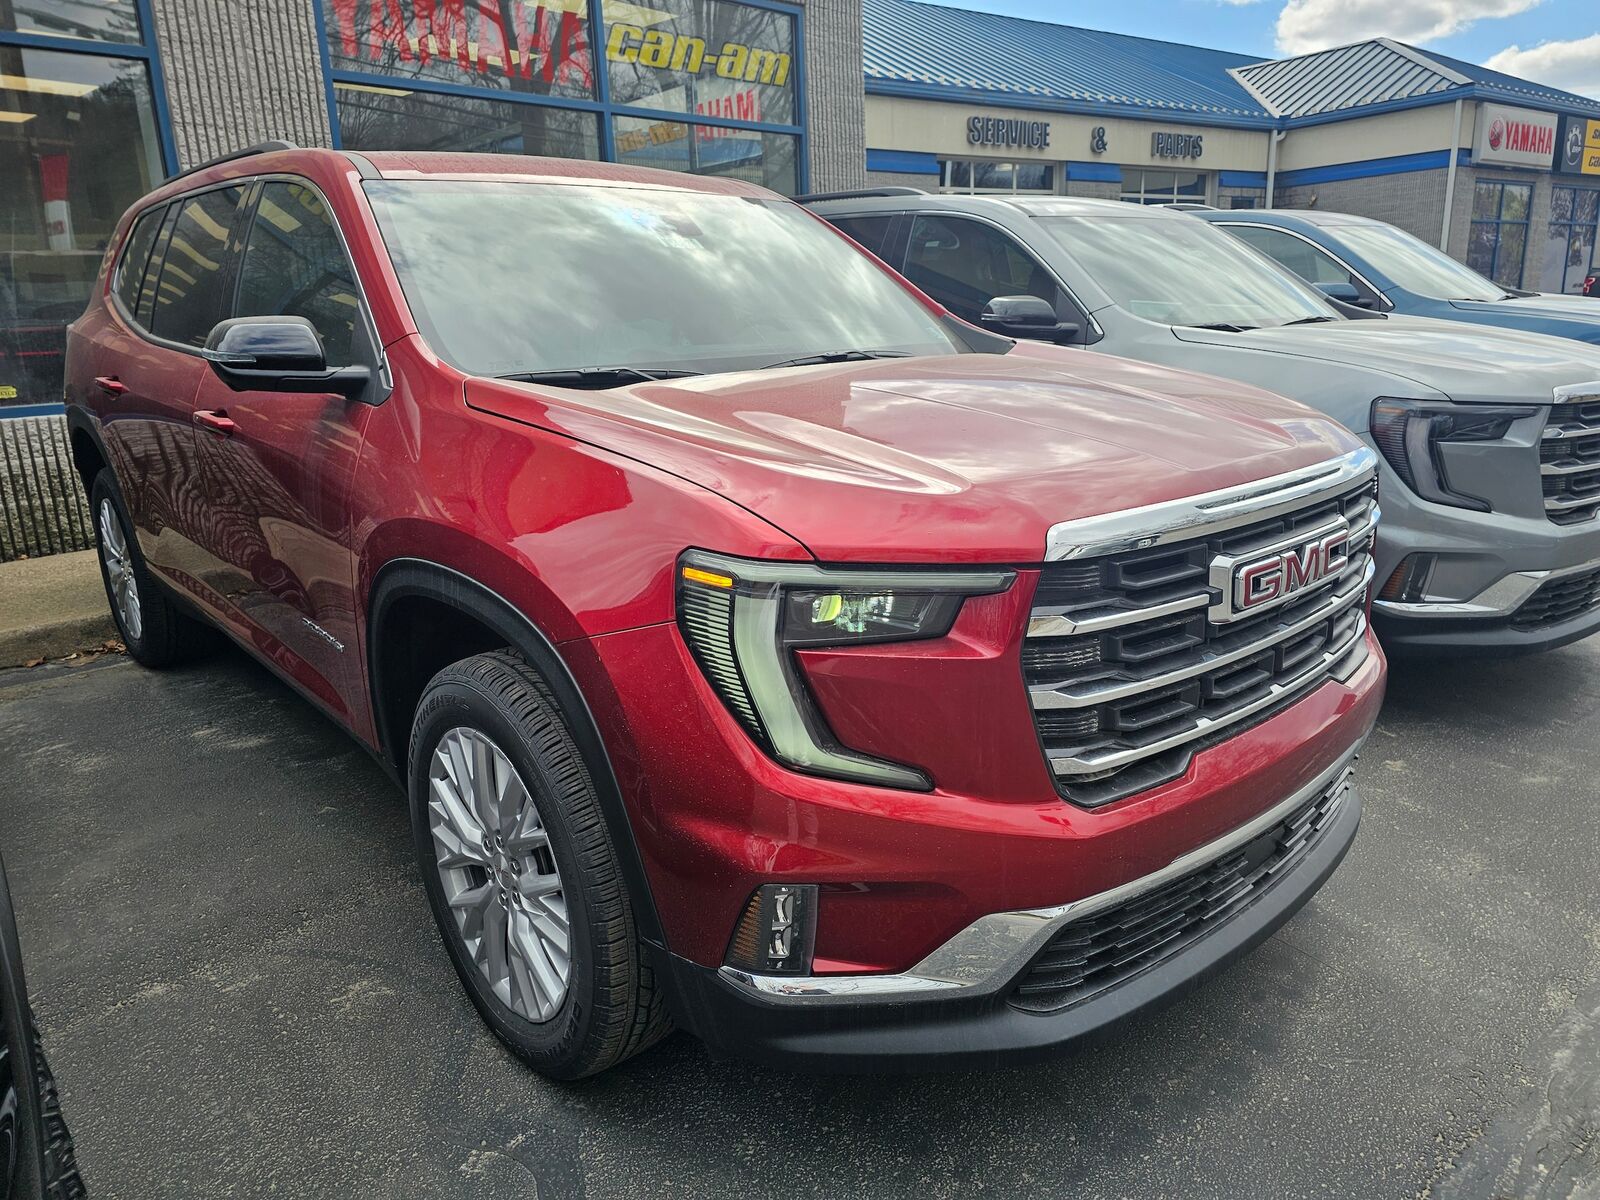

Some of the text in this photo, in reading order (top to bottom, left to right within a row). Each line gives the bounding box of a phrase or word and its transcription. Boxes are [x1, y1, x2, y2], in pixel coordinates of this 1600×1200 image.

[606, 23, 791, 87] can-am
[967, 115, 1203, 159] SERVICE & PARTS
[1506, 121, 1552, 155] YAMAHA
[1234, 527, 1349, 611] GMC
